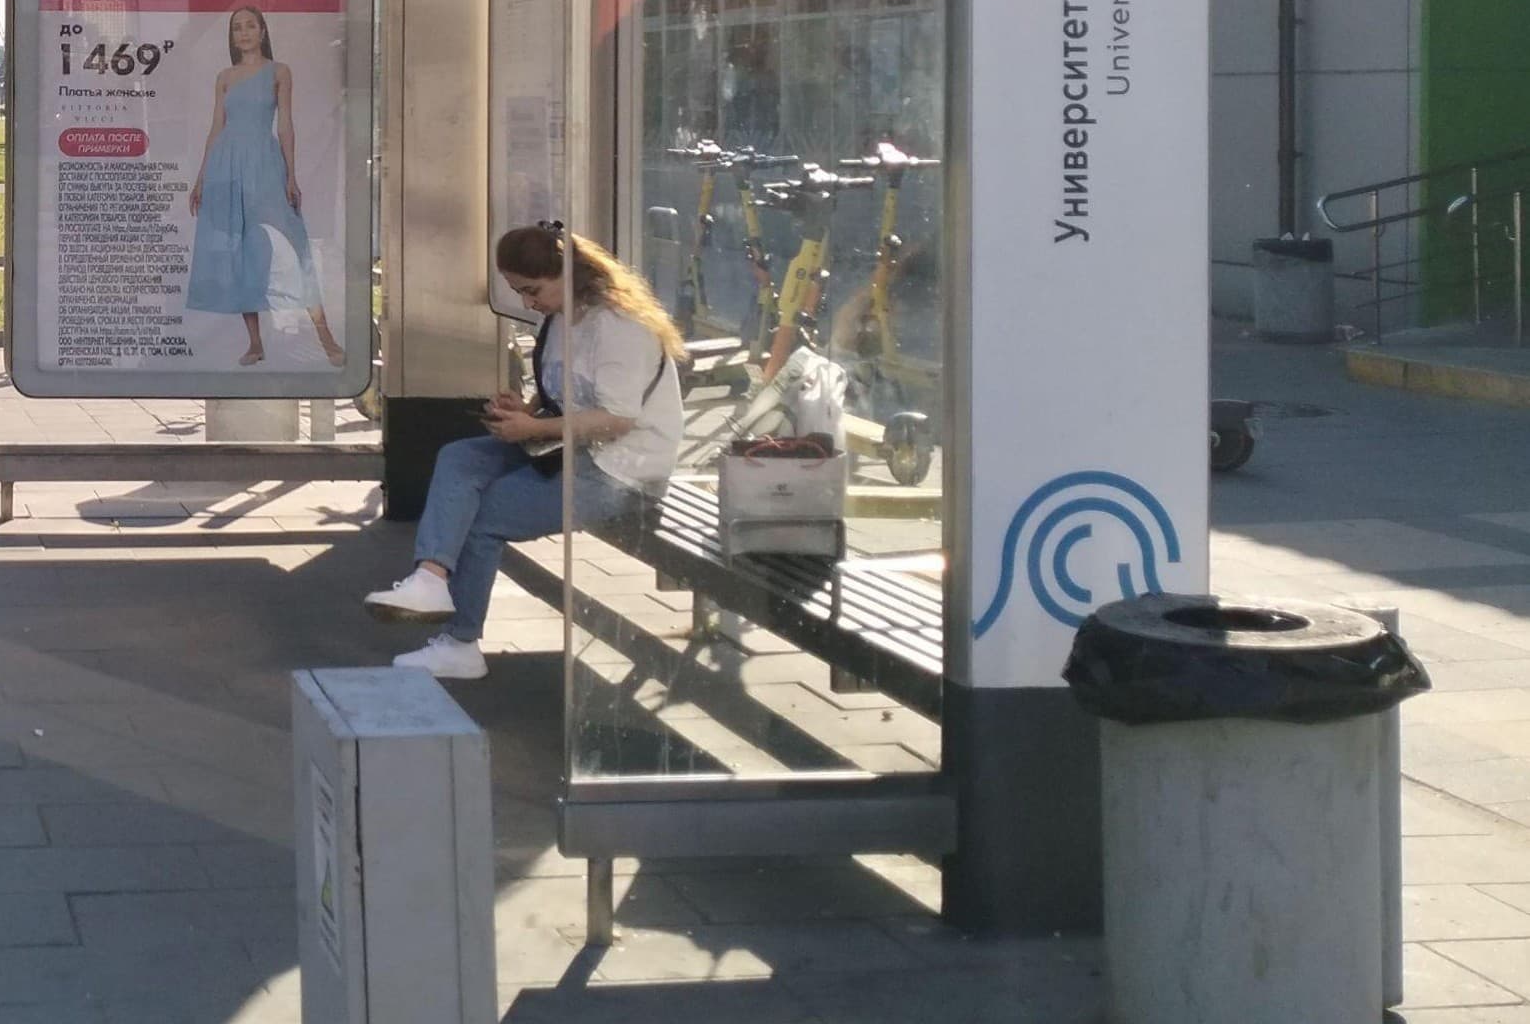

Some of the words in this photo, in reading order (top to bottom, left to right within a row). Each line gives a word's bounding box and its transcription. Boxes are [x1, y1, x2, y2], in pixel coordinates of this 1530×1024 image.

[60, 24, 83, 37] до
[58, 85, 102, 97] Платья
[106, 88, 157, 98] женские
[1054, 0, 1097, 243] Университет
[66, 133, 105, 143] ОПЛАТА
[107, 133, 143, 143] ПОСЛЕ
[77, 144, 131, 154] ПРИМЕРКИ
